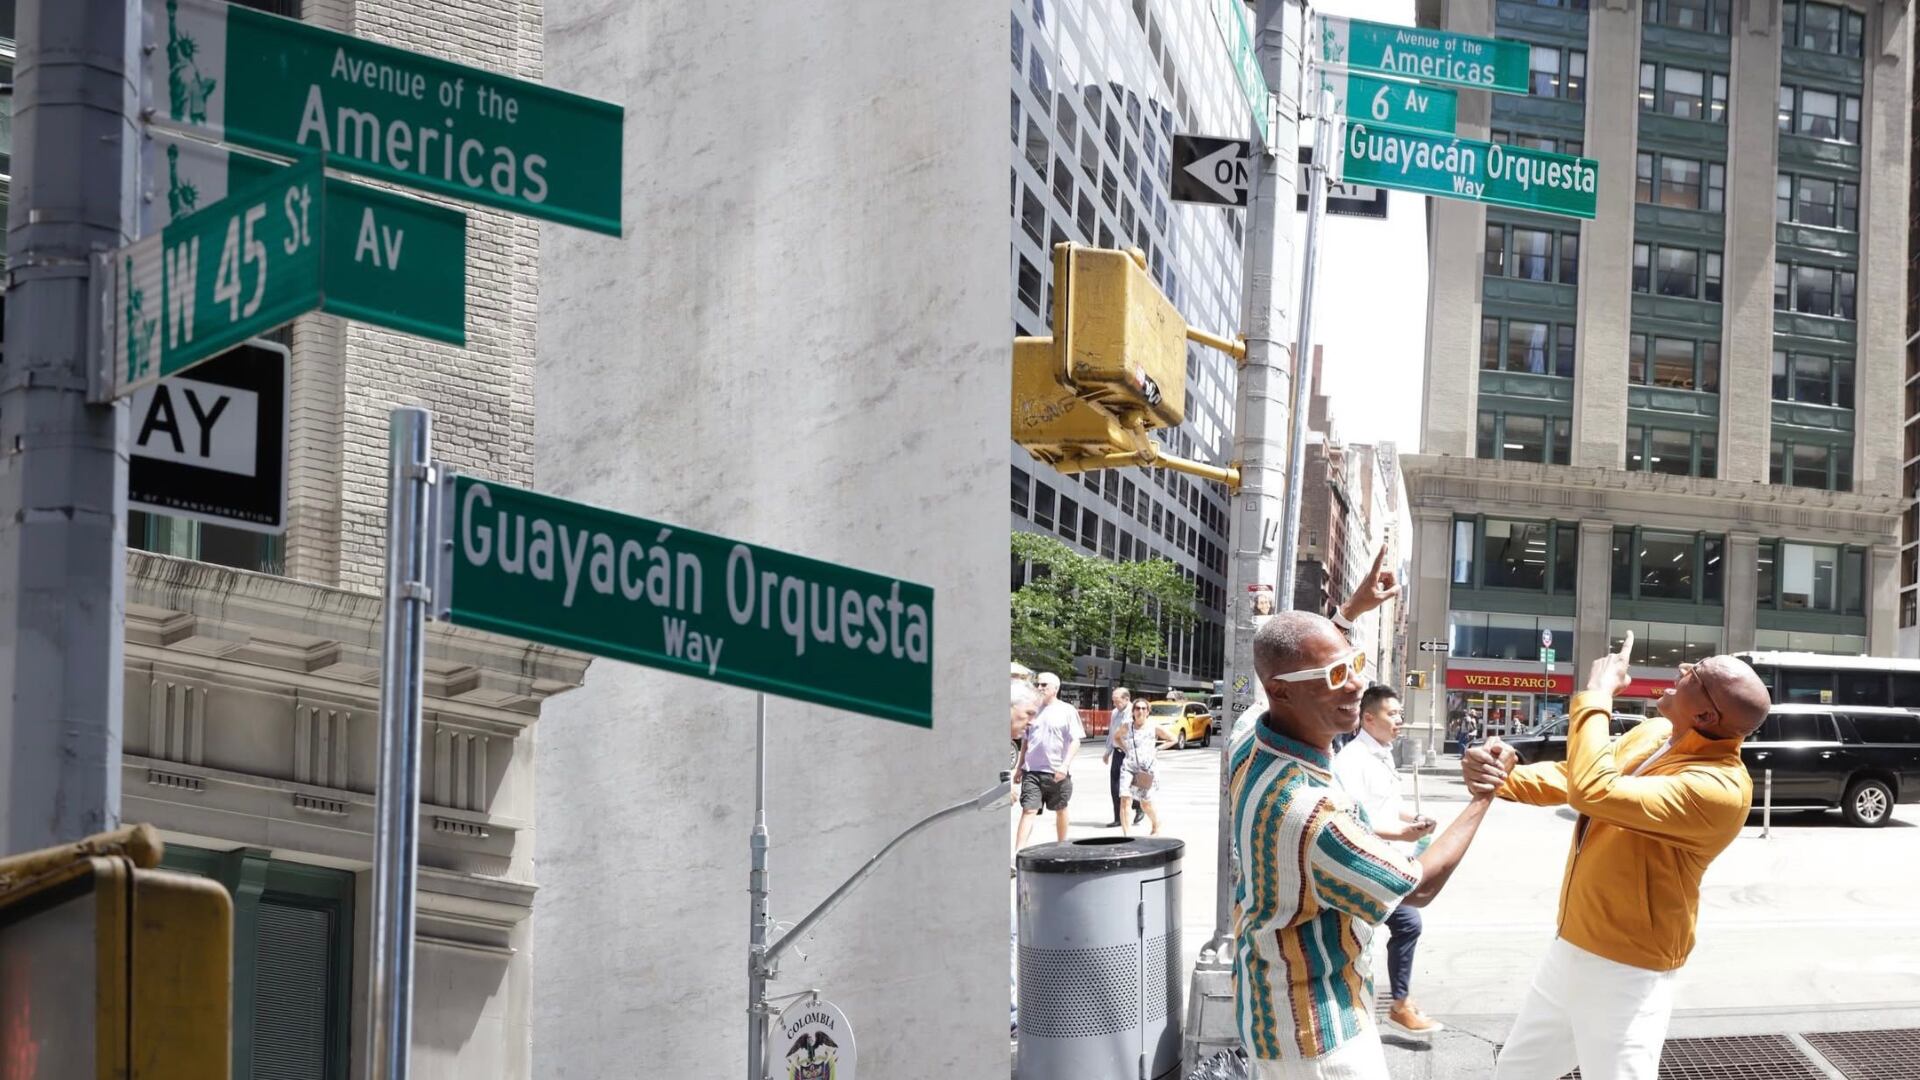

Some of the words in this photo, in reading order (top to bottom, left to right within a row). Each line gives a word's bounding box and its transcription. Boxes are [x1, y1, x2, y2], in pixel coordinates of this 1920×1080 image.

[1380, 44, 1495, 85] Americas
[1396, 30, 1440, 49] Avenue
[1445, 38, 1457, 51] of
[1463, 41, 1482, 55] the
[331, 47, 426, 100] Avenue
[438, 79, 464, 109] of
[477, 85, 518, 123] the
[1371, 85, 1390, 120] 6
[1405, 89, 1429, 113] Av
[296, 84, 549, 203] Americas
[1350, 124, 1475, 175] Guayacán
[1487, 144, 1595, 193] Orquesta
[1214, 159, 1249, 186] ON
[1453, 176, 1485, 199] Way
[355, 207, 404, 271] Av
[166, 235, 199, 350] W
[214, 202, 267, 322] 45
[284, 184, 311, 255] St
[136, 384, 231, 458] AY
[166, 497, 273, 522] TRANSPORTATION
[461, 482, 703, 615] Guayacán
[726, 544, 929, 664] Orquesta
[663, 615, 724, 675] Way
[1465, 675, 1510, 687] WELLS
[1513, 677, 1557, 688] FARGO
[786, 1012, 835, 1040] COLOMBIA
